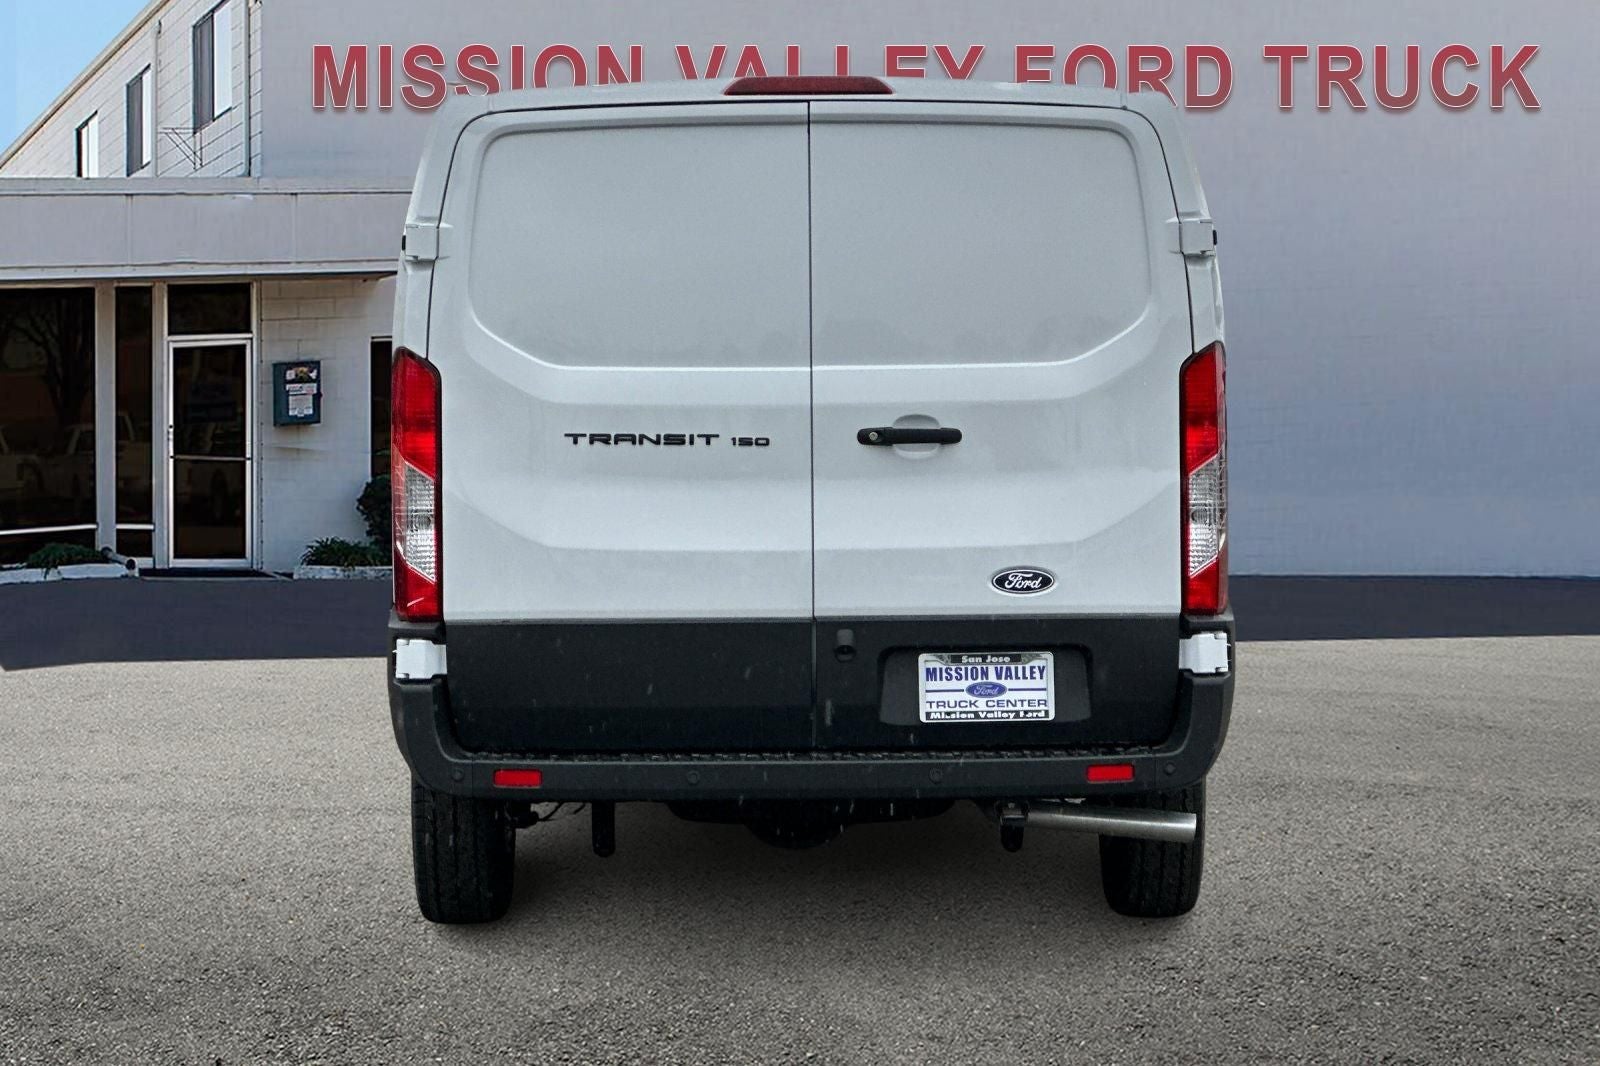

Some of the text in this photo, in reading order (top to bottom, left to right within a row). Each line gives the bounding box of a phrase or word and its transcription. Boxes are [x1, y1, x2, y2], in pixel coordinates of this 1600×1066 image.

[312, 44, 643, 108] MISSION
[1015, 44, 1233, 107] FORD
[1263, 44, 1541, 108] TRUCK
[564, 433, 770, 446] TRANSIT 150
[1004, 572, 1043, 589] Ford
[961, 655, 1011, 663] San Jose
[925, 665, 1046, 682] MISSION VALLEY
[973, 684, 999, 695] Ford
[925, 699, 1048, 709] TRUCK CENTER
